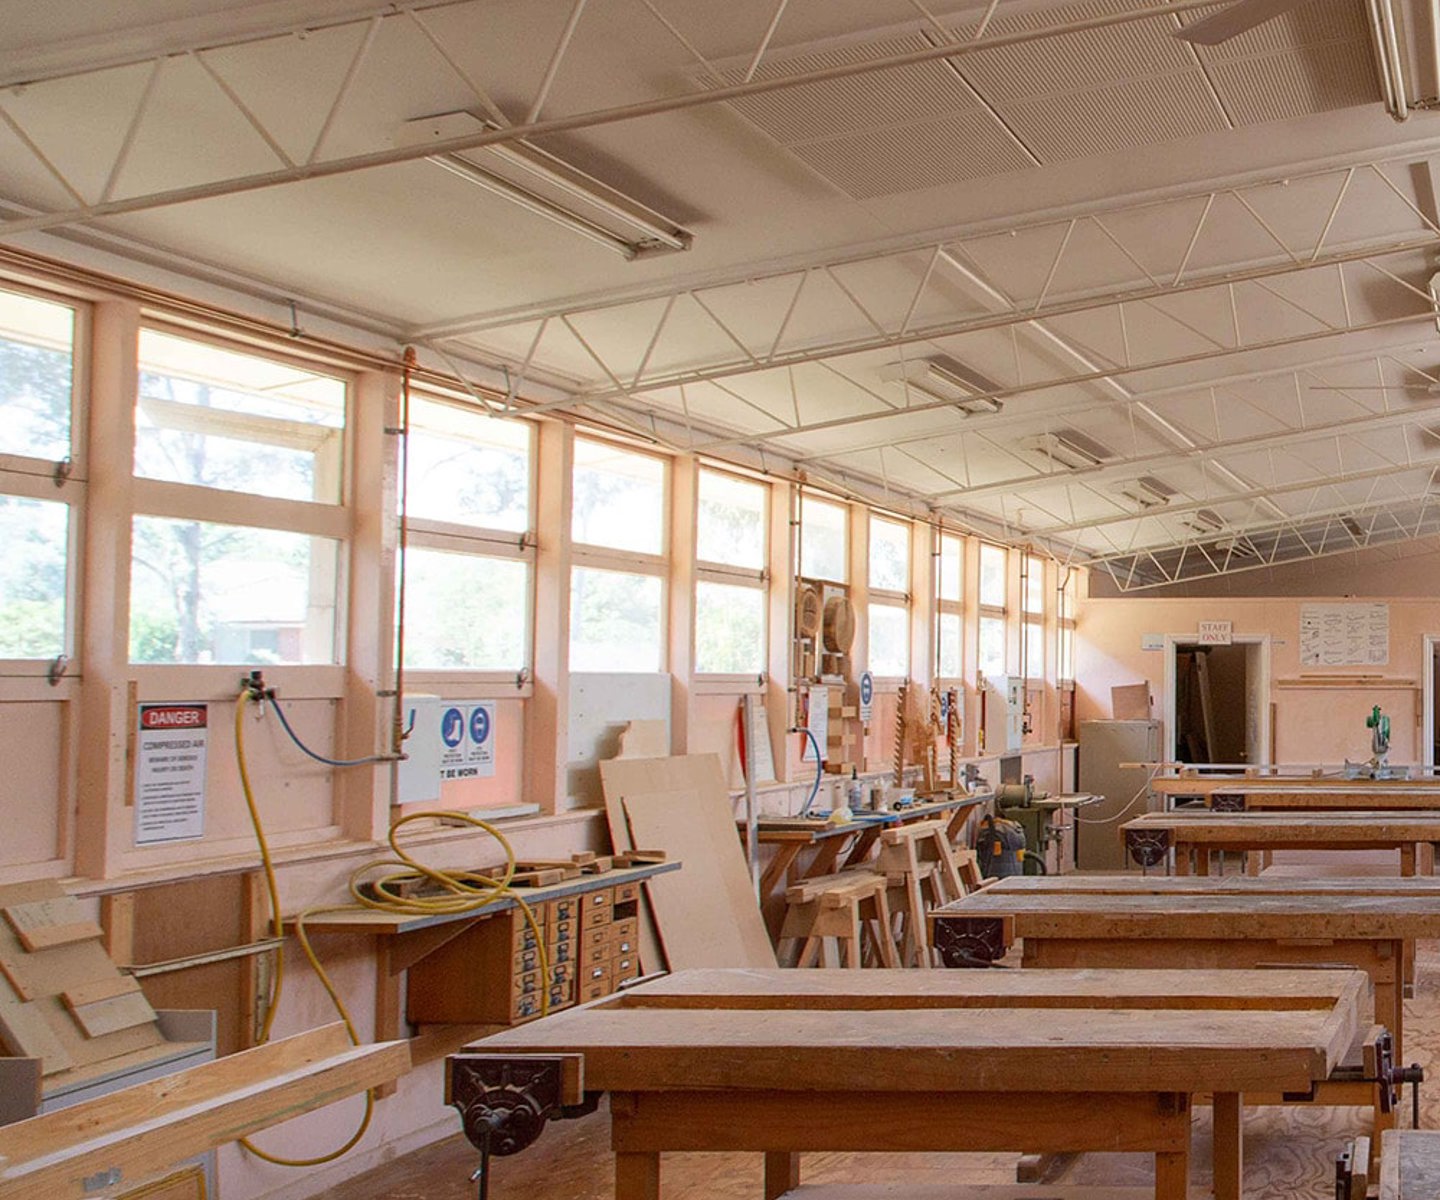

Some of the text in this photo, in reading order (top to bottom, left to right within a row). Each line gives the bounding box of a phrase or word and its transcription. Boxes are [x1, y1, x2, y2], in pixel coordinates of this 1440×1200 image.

[1201, 623, 1229, 631] STAFF
[1202, 634, 1227, 642] ONLY
[149, 711, 200, 724] DANGER
[446, 769, 455, 778] BE
[458, 767, 477, 776] WORN
